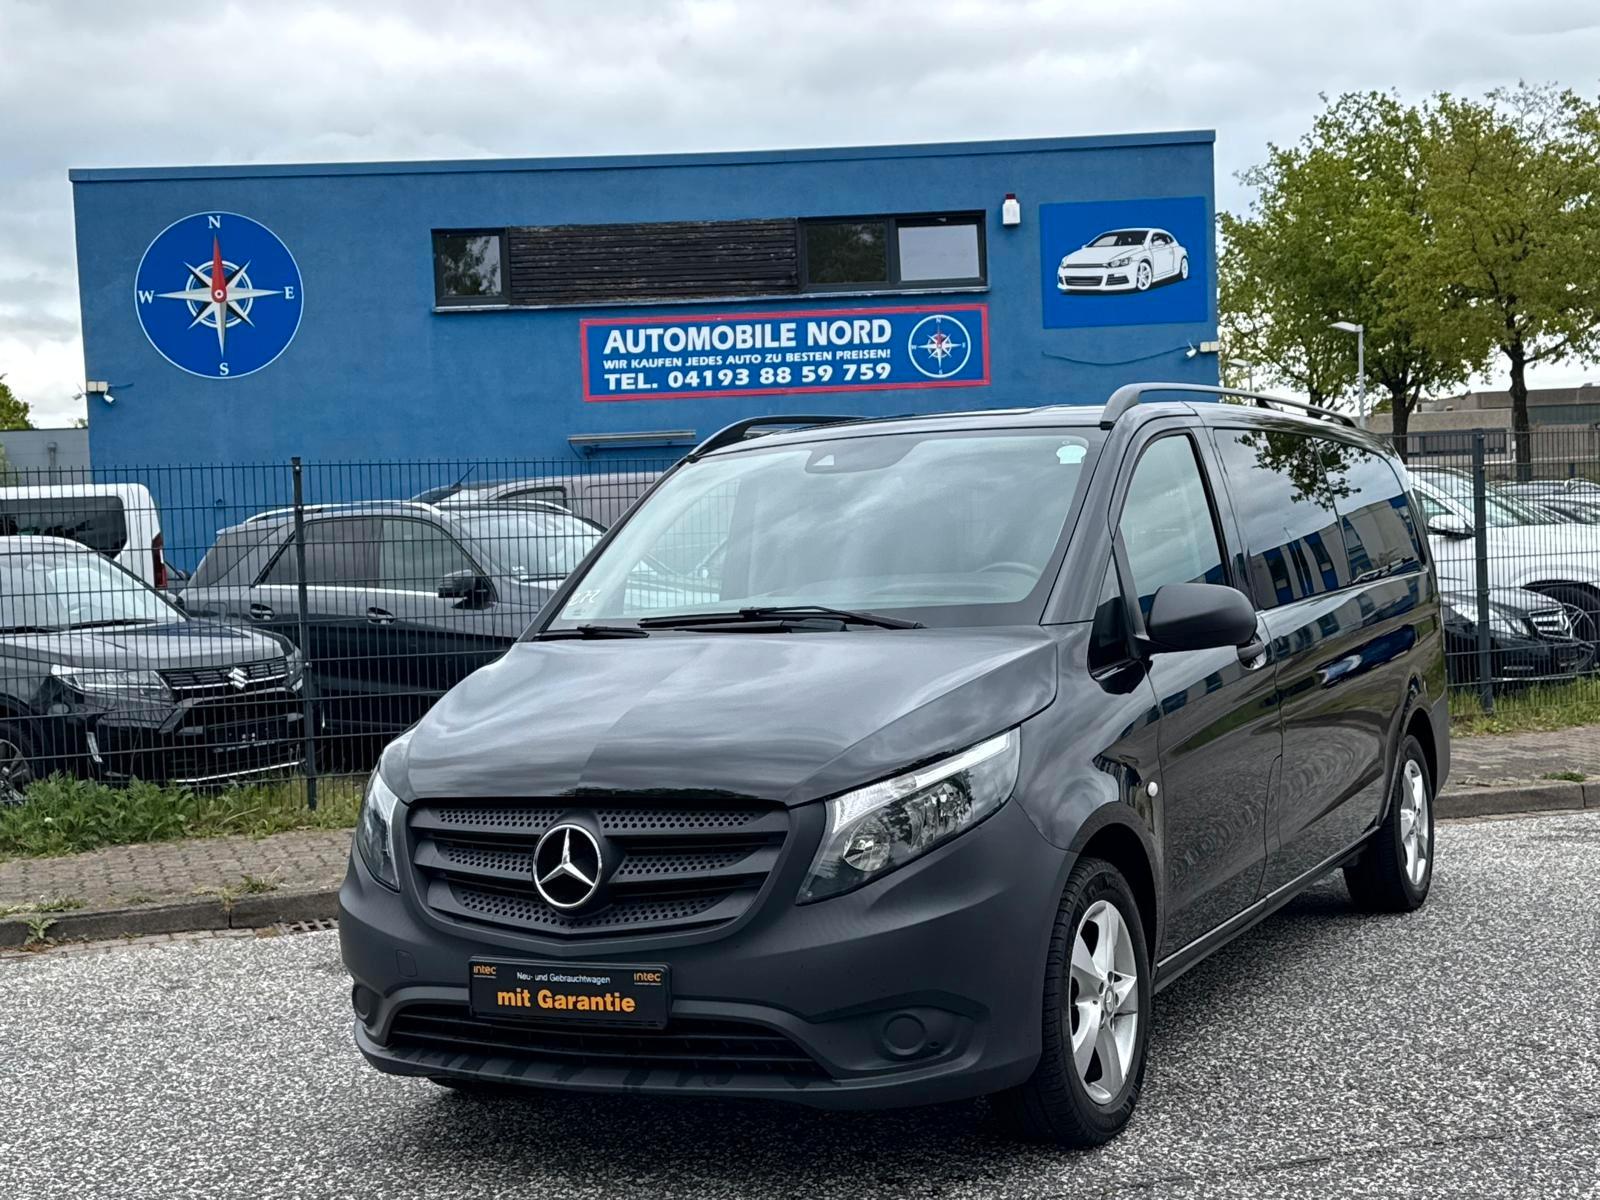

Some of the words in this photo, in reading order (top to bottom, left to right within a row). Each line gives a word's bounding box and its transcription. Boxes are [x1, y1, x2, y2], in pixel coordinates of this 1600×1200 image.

[208, 215, 221, 229] N
[138, 290, 154, 304] W
[284, 286, 295, 300] E
[603, 322, 797, 355] AUTOMOBILE
[807, 318, 892, 347] NORD
[602, 359, 628, 370] WIR
[631, 357, 682, 369] KAUFEN
[685, 355, 723, 367] JEDES
[725, 353, 762, 365] AUTO
[764, 353, 782, 364] ZU
[785, 351, 833, 363] BESTEN
[835, 348, 891, 361] PREISEN!
[219, 362, 229, 376] S
[604, 372, 658, 390] TEL.
[667, 368, 750, 389] 04193
[759, 366, 793, 385] 88
[801, 364, 834, 383] 59
[842, 362, 892, 381] 759
[473, 965, 497, 975] intec
[633, 972, 662, 982] intec
[516, 971, 534, 981] Neu-
[534, 973, 548, 982] und
[549, 973, 611, 986] Gebrauchtwagen
[497, 987, 531, 1008] mit
[537, 989, 636, 1013] Garantie
